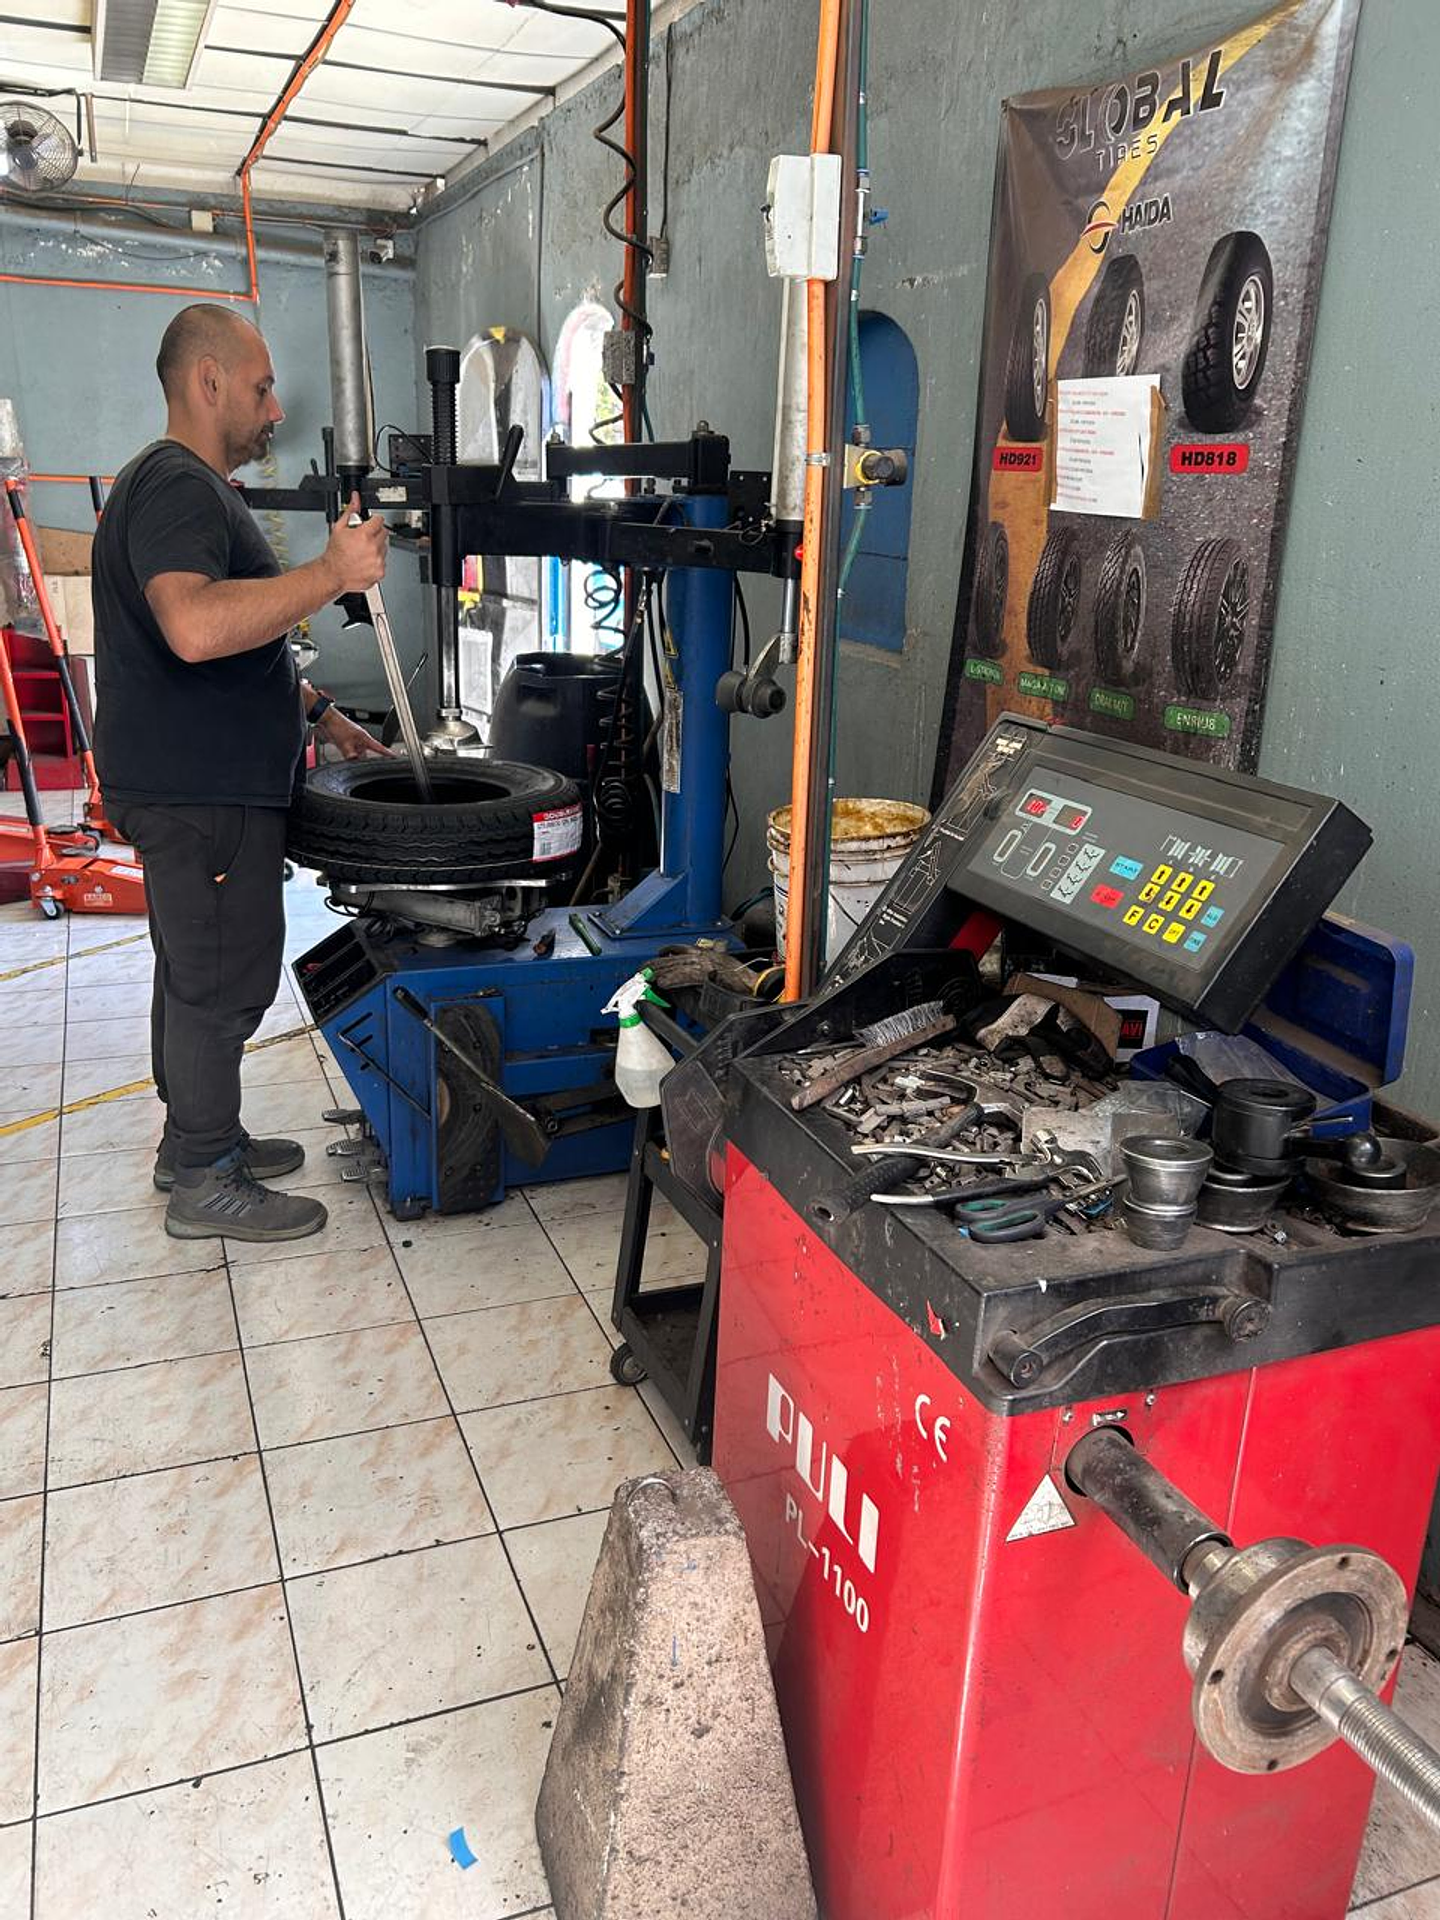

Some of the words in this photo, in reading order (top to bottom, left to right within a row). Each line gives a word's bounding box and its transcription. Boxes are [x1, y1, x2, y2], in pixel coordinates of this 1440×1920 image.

[1056, 49, 1227, 160] GLOBAL
[1096, 134, 1159, 172] TIRES
[1120, 193, 1174, 235] HAIDA
[999, 450, 1038, 466] HD921
[1181, 450, 1237, 467] HD818
[1127, 910, 1140, 921] F
[1148, 918, 1160, 930] C
[915, 1393, 951, 1463] CE
[766, 1372, 880, 1574] PULI
[785, 1492, 870, 1634] PL-1100
